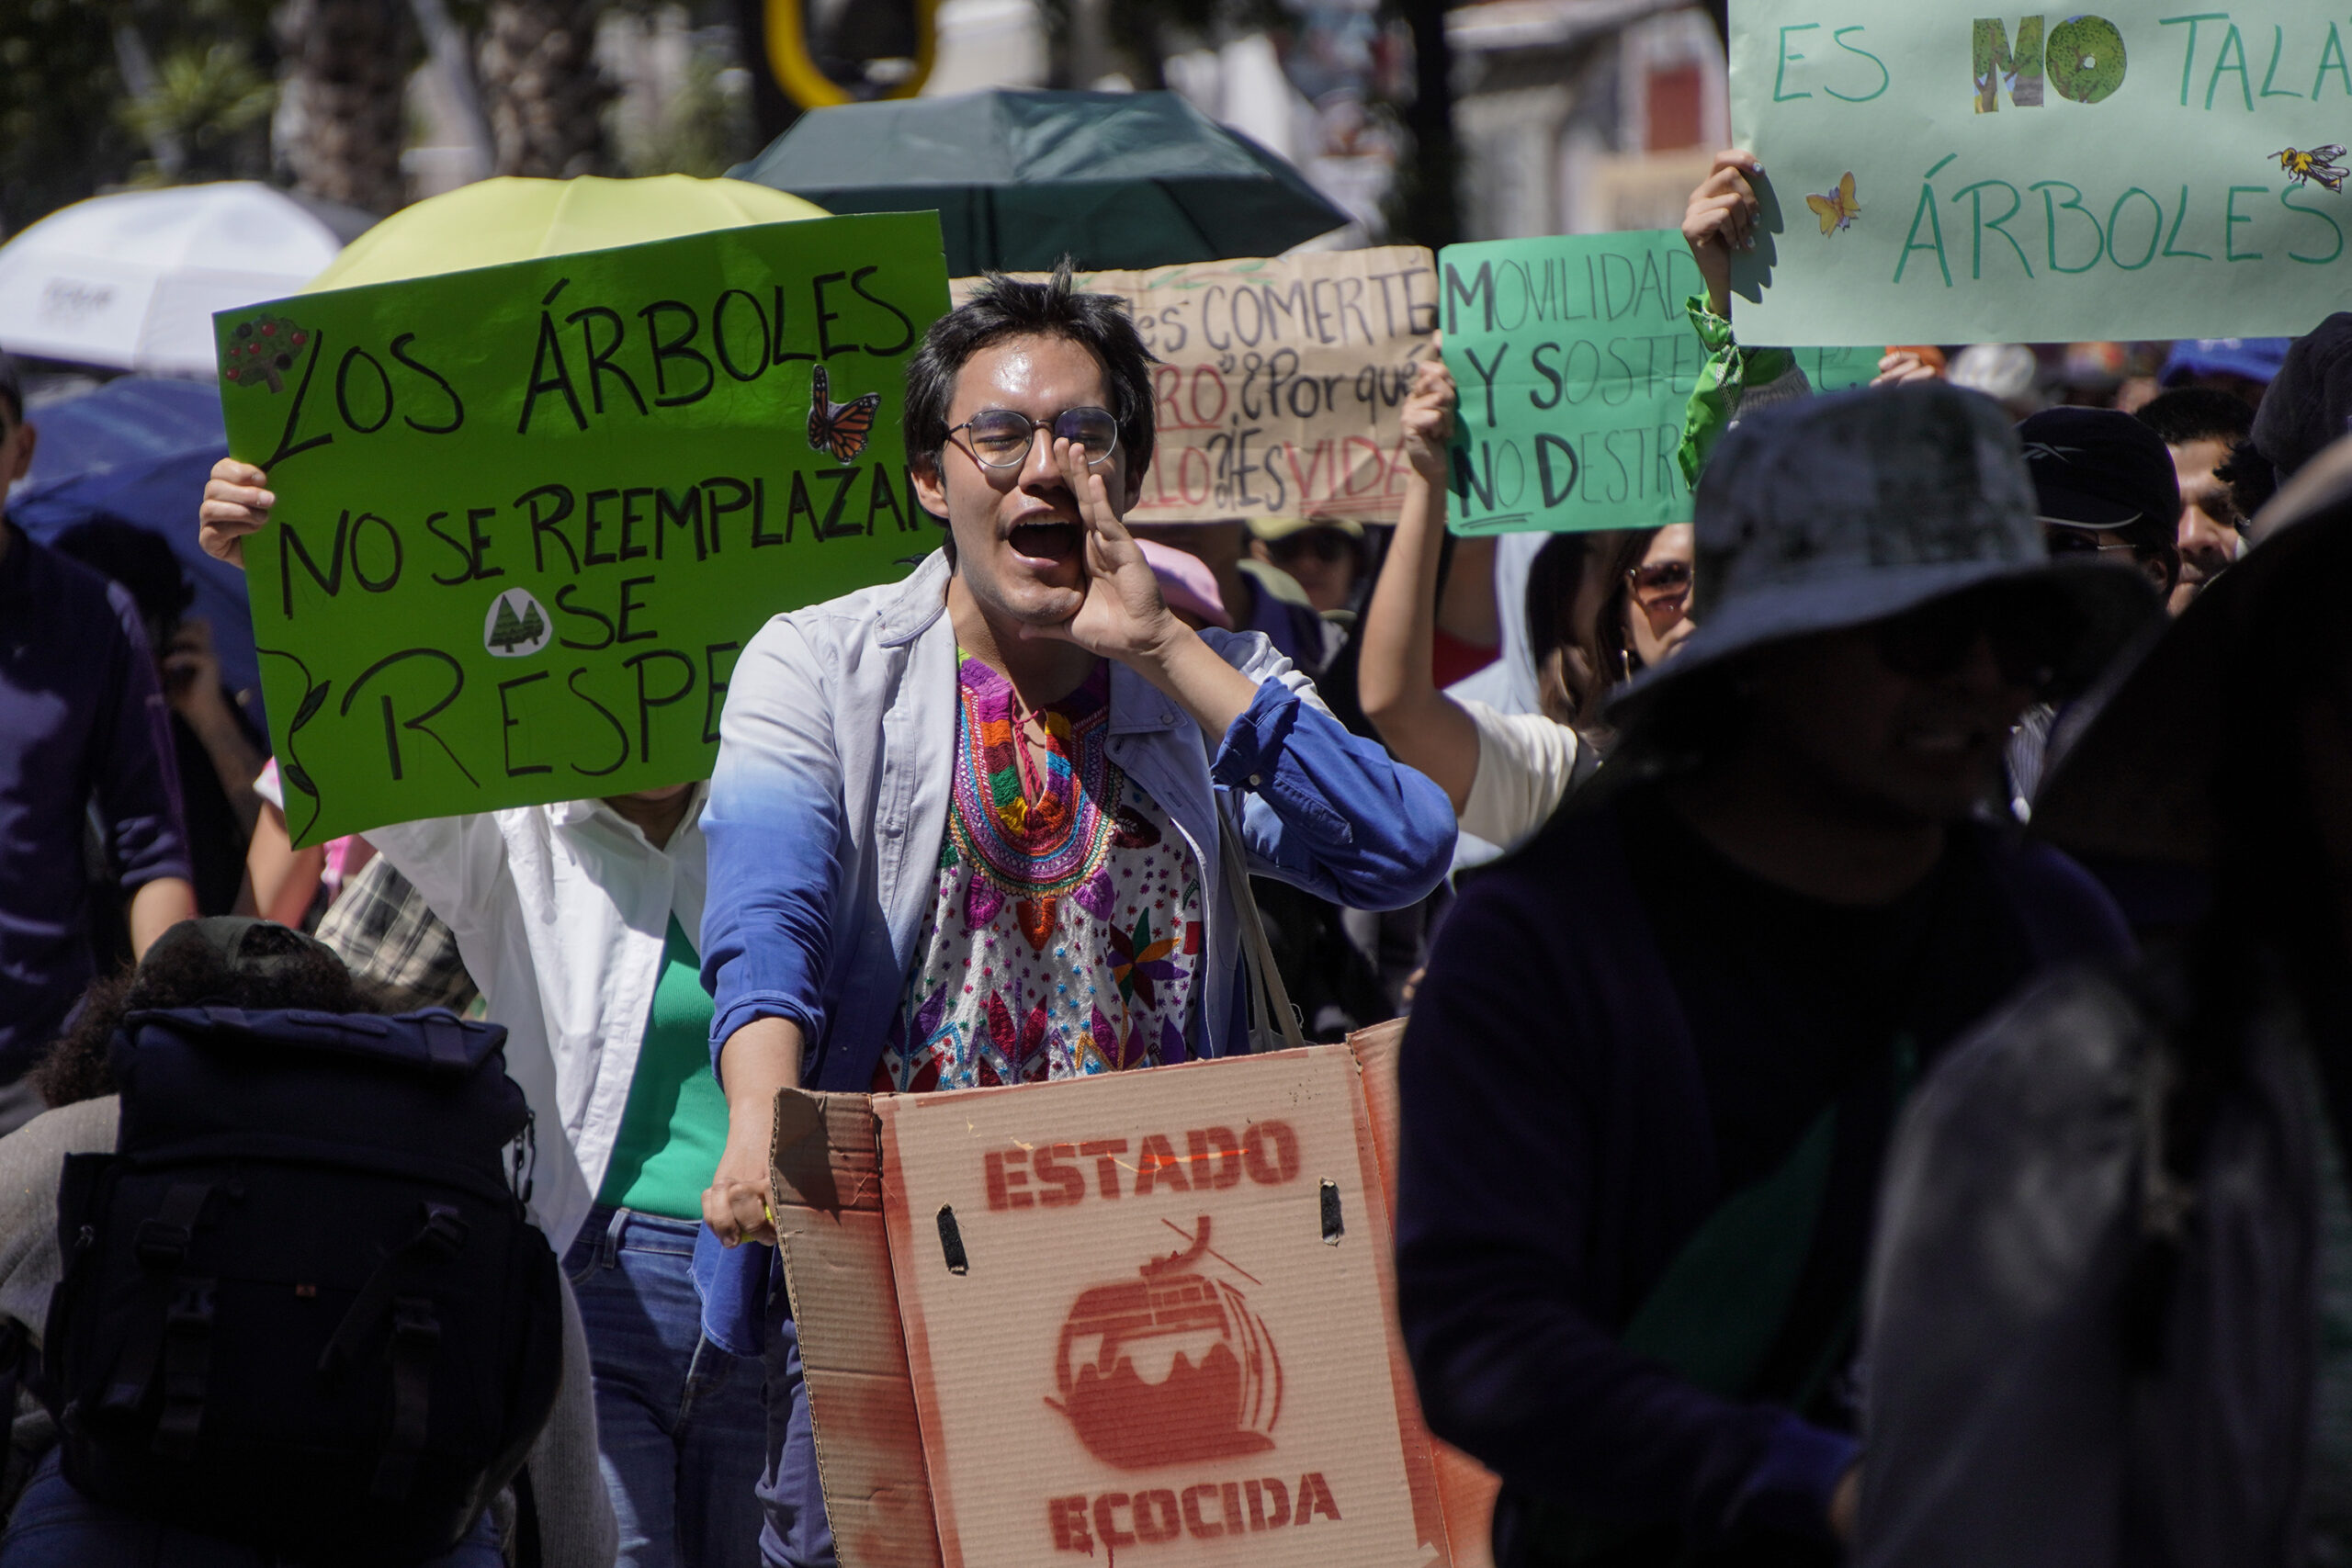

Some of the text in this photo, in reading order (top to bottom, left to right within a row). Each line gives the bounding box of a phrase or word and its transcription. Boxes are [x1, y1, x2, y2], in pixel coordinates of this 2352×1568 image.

[1774, 12, 2352, 115] ES NO TALA
[1893, 152, 2344, 288] ÁRBOLES
[1444, 248, 1704, 335] MOVILIDAD
[260, 264, 918, 471] LOS ÁRBOLES
[1464, 342, 1510, 428] Y
[1452, 423, 1678, 518] NO DESTR
[278, 462, 920, 620] NO SE REEMPLAZA
[555, 576, 659, 650] SE
[340, 642, 740, 789] RESPE
[984, 1120, 1303, 1213] ESTADO
[1047, 1472, 1342, 1554] ECOCIDA
